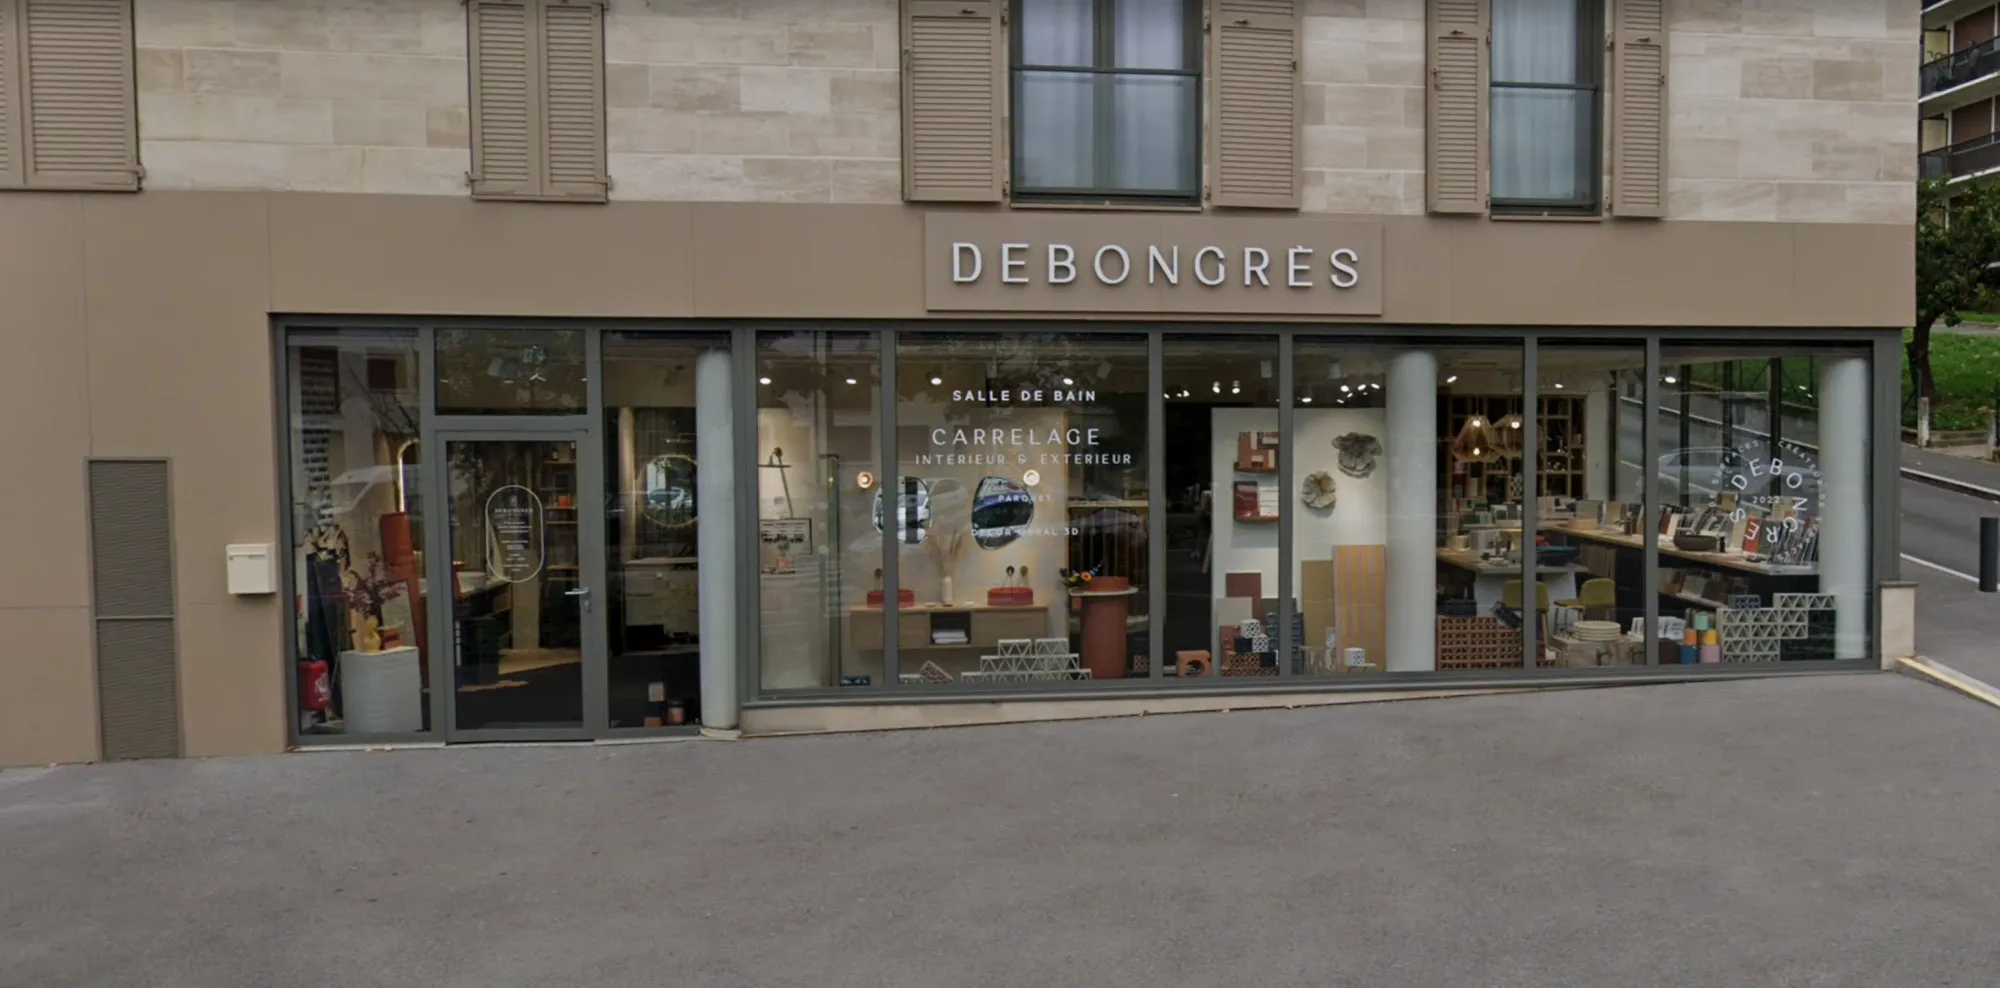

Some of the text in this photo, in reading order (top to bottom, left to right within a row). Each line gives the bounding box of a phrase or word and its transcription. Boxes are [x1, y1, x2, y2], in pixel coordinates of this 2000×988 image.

[952, 242, 1360, 288] DEBONGRÈS
[953, 391, 1096, 401] SALLE DE BAIN
[932, 428, 1100, 445] CARRELAGE
[915, 454, 1005, 465] INTERIEUR
[1040, 454, 1132, 465] EXTERIEUR
[1064, 528, 1079, 537] 3D
